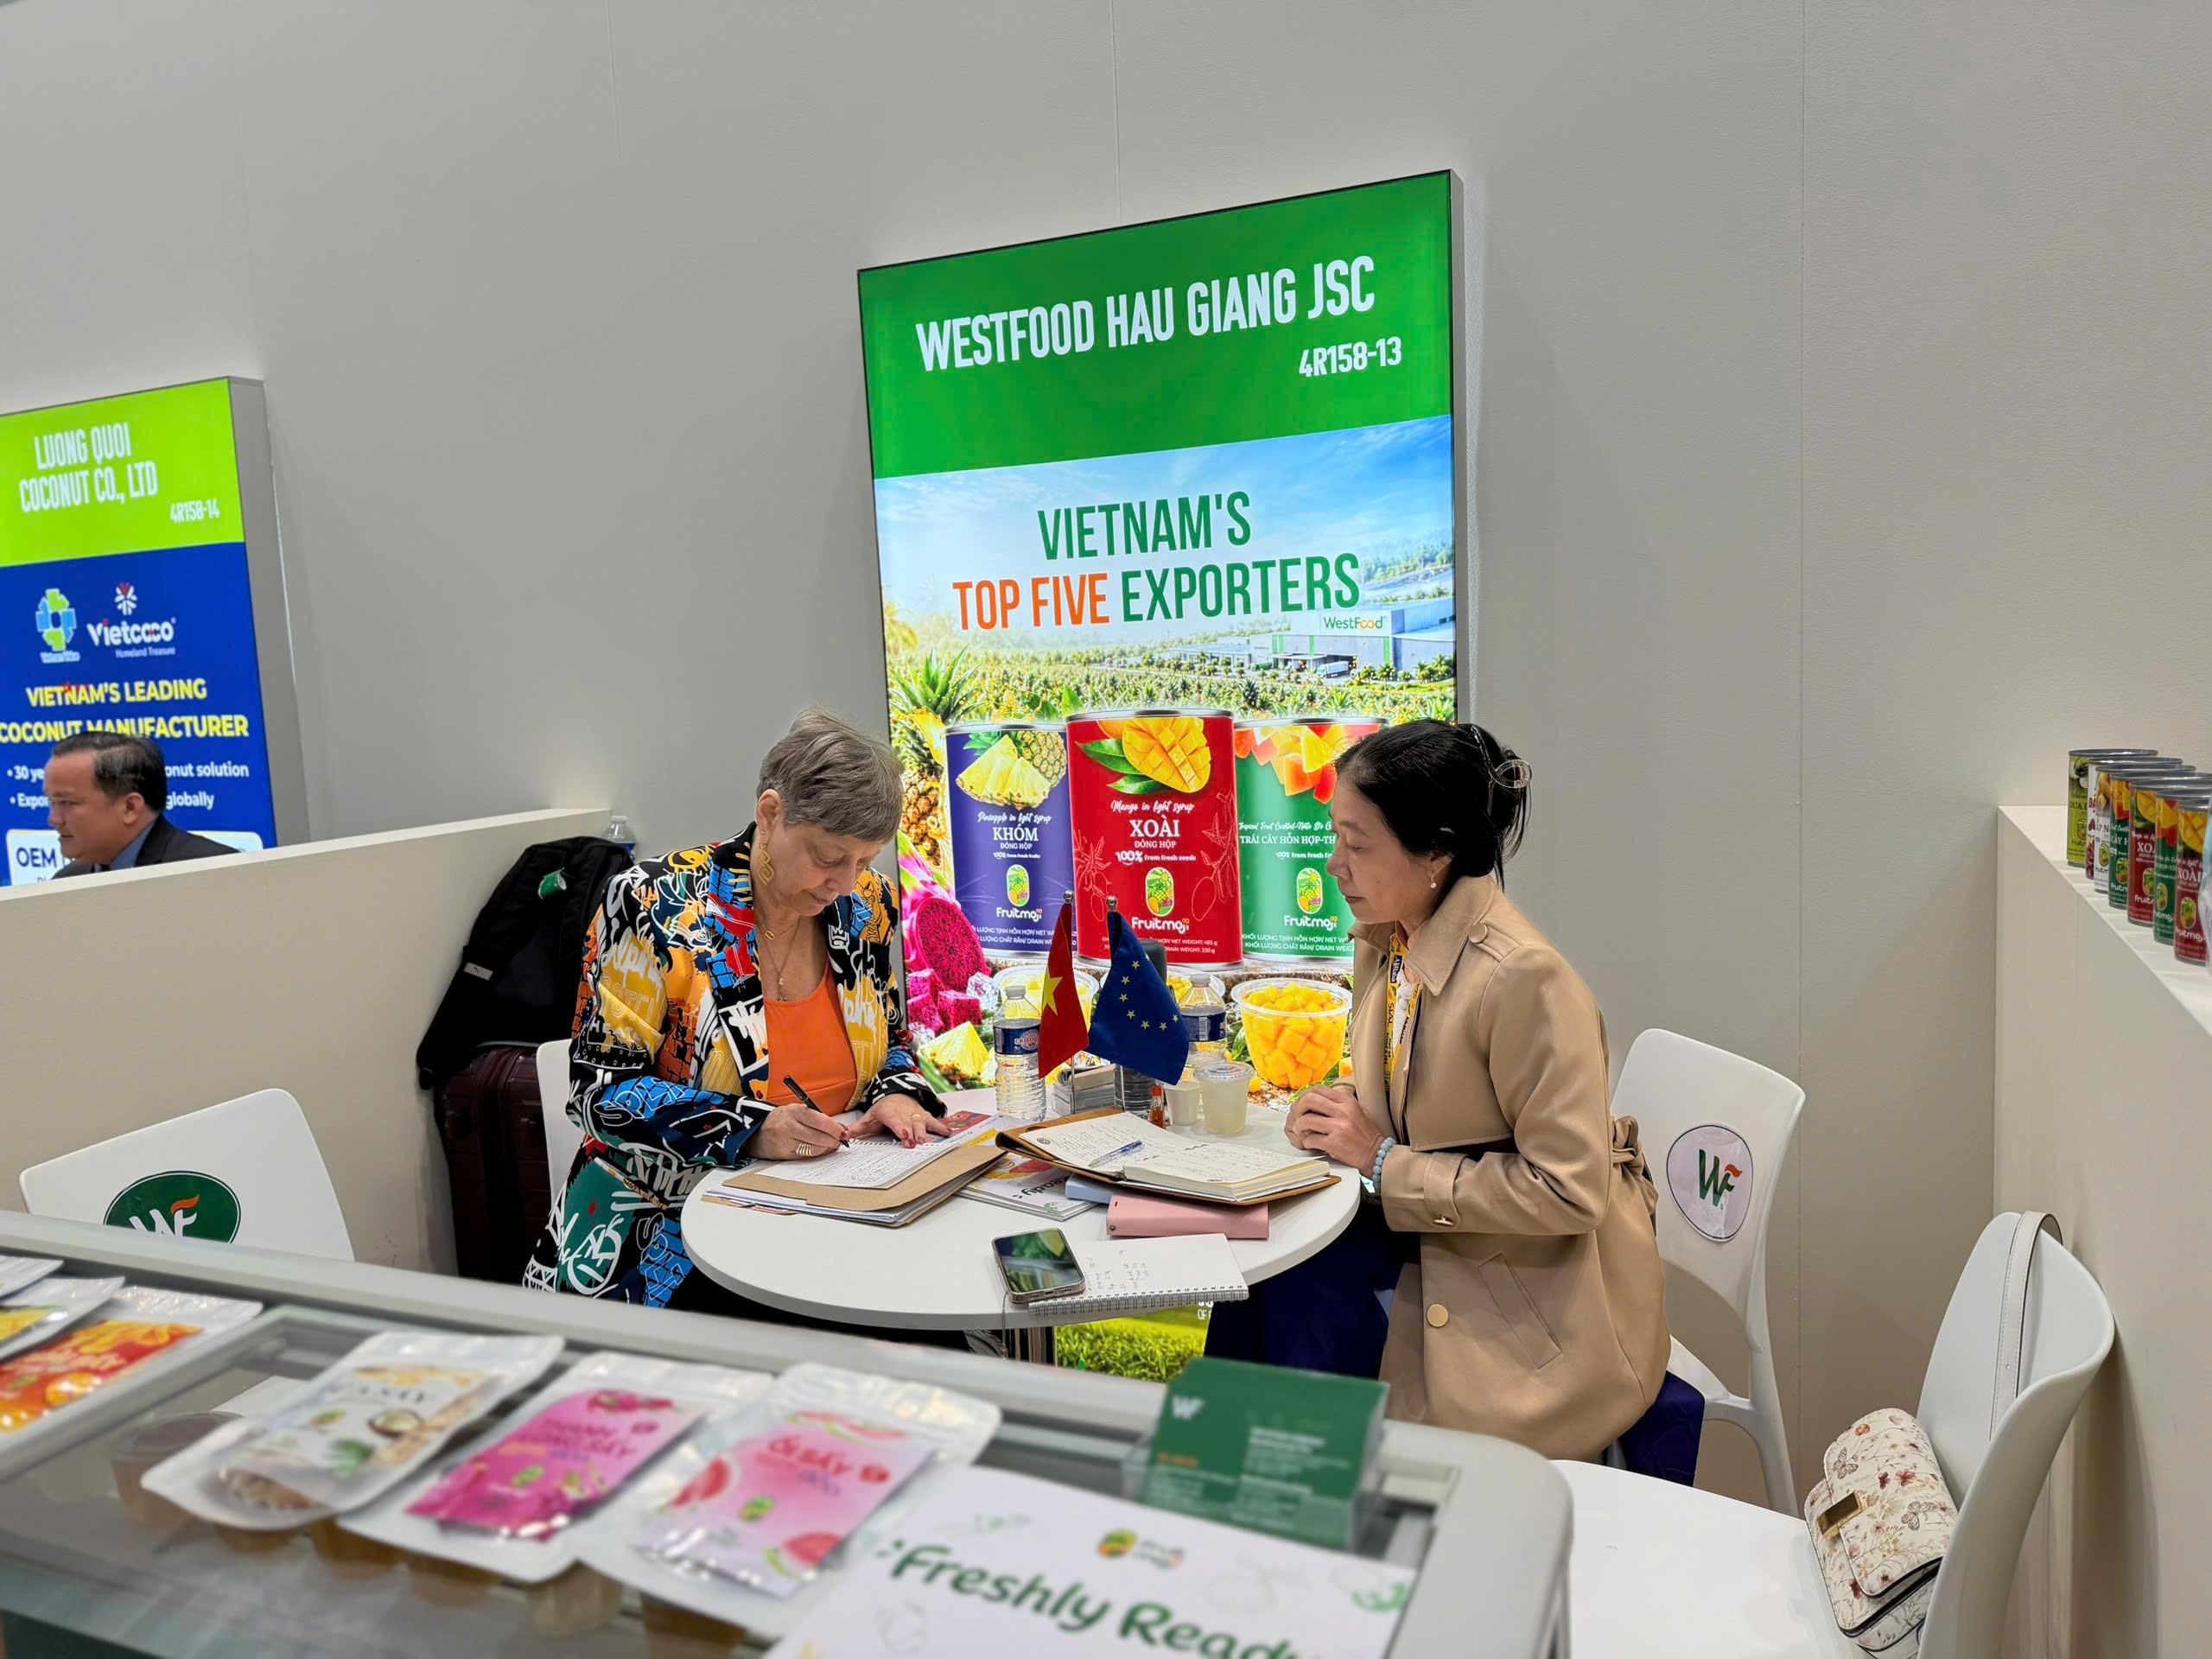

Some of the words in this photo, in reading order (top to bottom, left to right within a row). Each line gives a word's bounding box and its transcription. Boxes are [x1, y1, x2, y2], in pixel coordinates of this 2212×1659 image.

[915, 300, 1095, 372] WESTFOOD
[1106, 287, 1175, 347] HAU
[1186, 268, 1296, 337] GIANG
[1306, 256, 1376, 319] JSC
[1298, 336, 1403, 378] 4R158-13
[34, 429, 88, 470] LUONG
[90, 422, 131, 464] QUOI
[19, 470, 90, 512] COCONUT
[93, 467, 125, 504] CO.,
[127, 461, 159, 498] LTD
[170, 499, 220, 523] 4R158-14
[1037, 491, 1251, 560] VIETNAM'S
[952, 579, 1020, 630] TOP
[1031, 572, 1110, 626] FIVE
[1121, 552, 1360, 621] EXPORTERS
[1324, 616, 1383, 630] WestFood
[115, 649, 147, 658] Homeland
[149, 646, 175, 657] Treasure
[26, 682, 120, 707] VIETNAM'S
[124, 678, 207, 702] LEADING
[0, 721, 82, 743] COCONUT
[86, 715, 249, 737] MANUFACTURER
[13, 766, 29, 780] 30
[30, 768, 45, 783] ye
[164, 763, 194, 778] onut
[196, 760, 250, 778] solution
[166, 791, 214, 810] globally
[1110, 800, 1138, 814] Mango
[1141, 802, 1150, 810] in
[1153, 800, 1172, 814] light
[1173, 802, 1194, 814] syrup
[992, 823, 1039, 842] KHÓM
[1129, 815, 1180, 837] XOÀI
[16, 847, 57, 868] OEM
[1116, 850, 1143, 863] 100%
[996, 907, 1042, 922] Fruitmoji
[1131, 917, 1190, 934] Fruitmoji
[1284, 915, 1338, 931] Fruitmoji
[1021, 1175, 1070, 1197] eady
[890, 1545, 1110, 1632] Freshly
[1119, 1602, 1303, 1659] Rea
